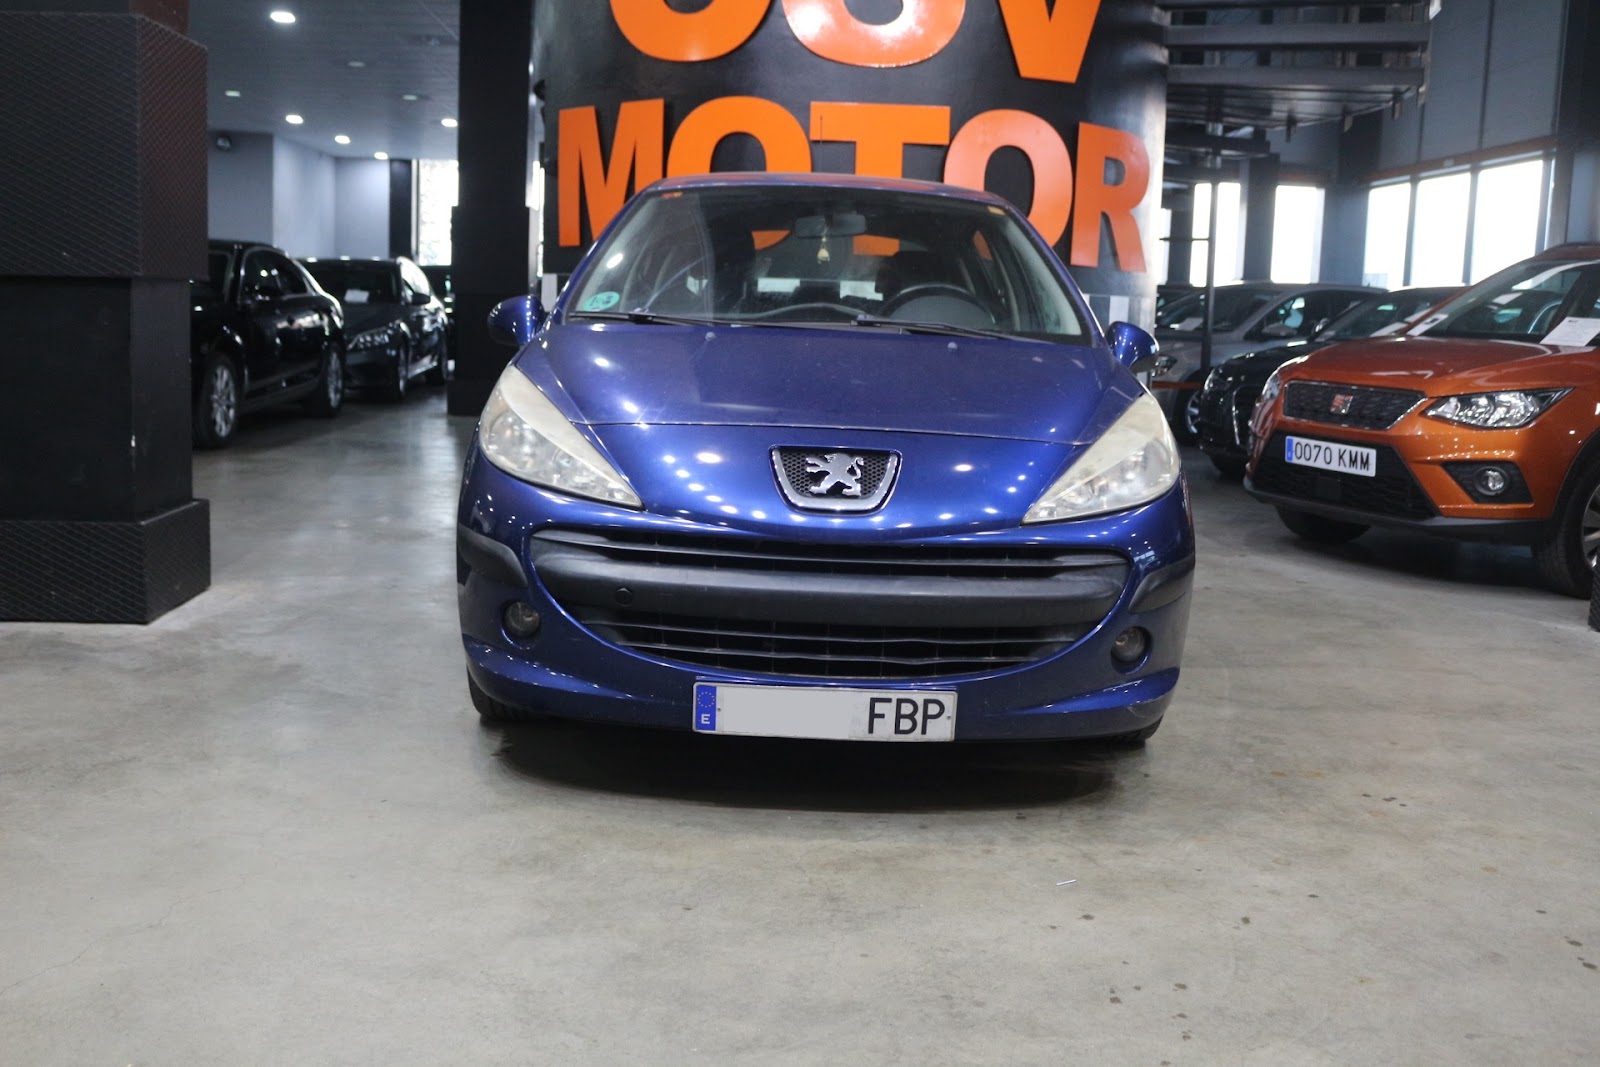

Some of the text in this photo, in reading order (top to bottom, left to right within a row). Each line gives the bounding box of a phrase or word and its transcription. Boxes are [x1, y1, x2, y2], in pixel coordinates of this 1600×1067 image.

[1294, 441, 1370, 472] 0070 KMM
[701, 697, 946, 736] E FBP
